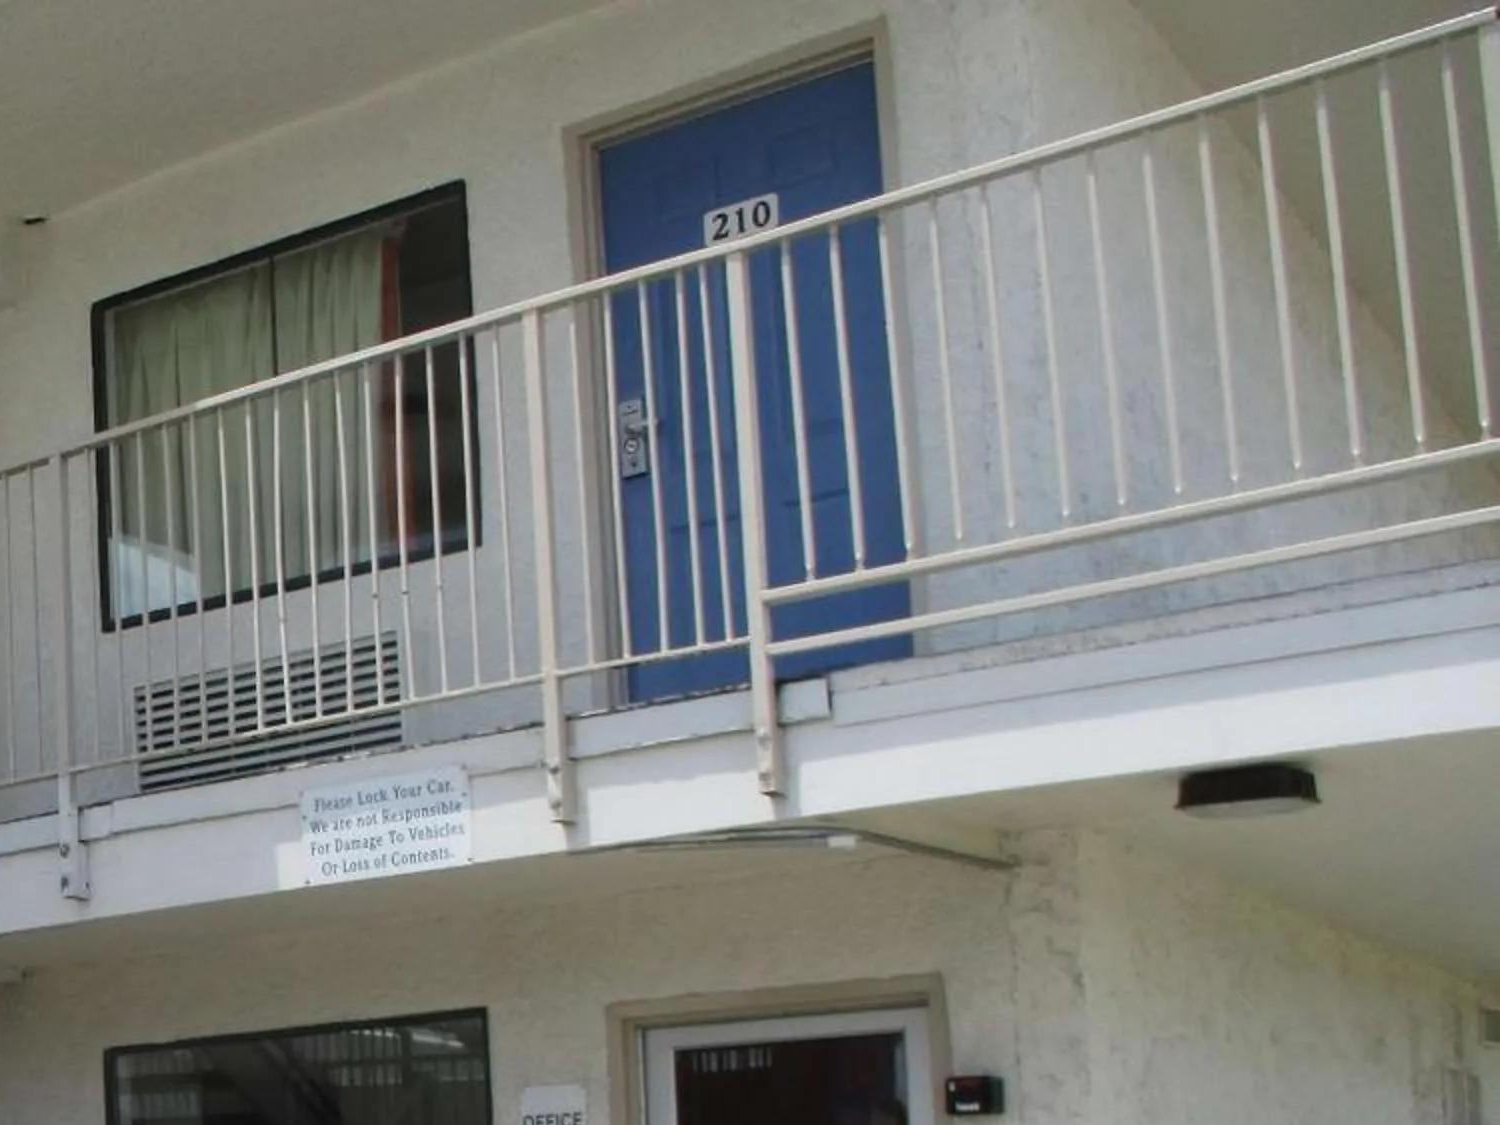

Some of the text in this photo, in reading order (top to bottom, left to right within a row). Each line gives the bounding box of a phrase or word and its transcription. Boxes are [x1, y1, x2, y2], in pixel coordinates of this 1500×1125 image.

[711, 200, 772, 241] 210
[313, 796, 353, 813] Please
[357, 788, 389, 806] Lock
[392, 784, 422, 800] Your
[309, 799, 463, 833] We are not Responsible
[310, 821, 465, 857] For Damage To Vehicles
[321, 861, 338, 877] Or
[342, 858, 370, 873] Loss
[374, 853, 387, 869] of
